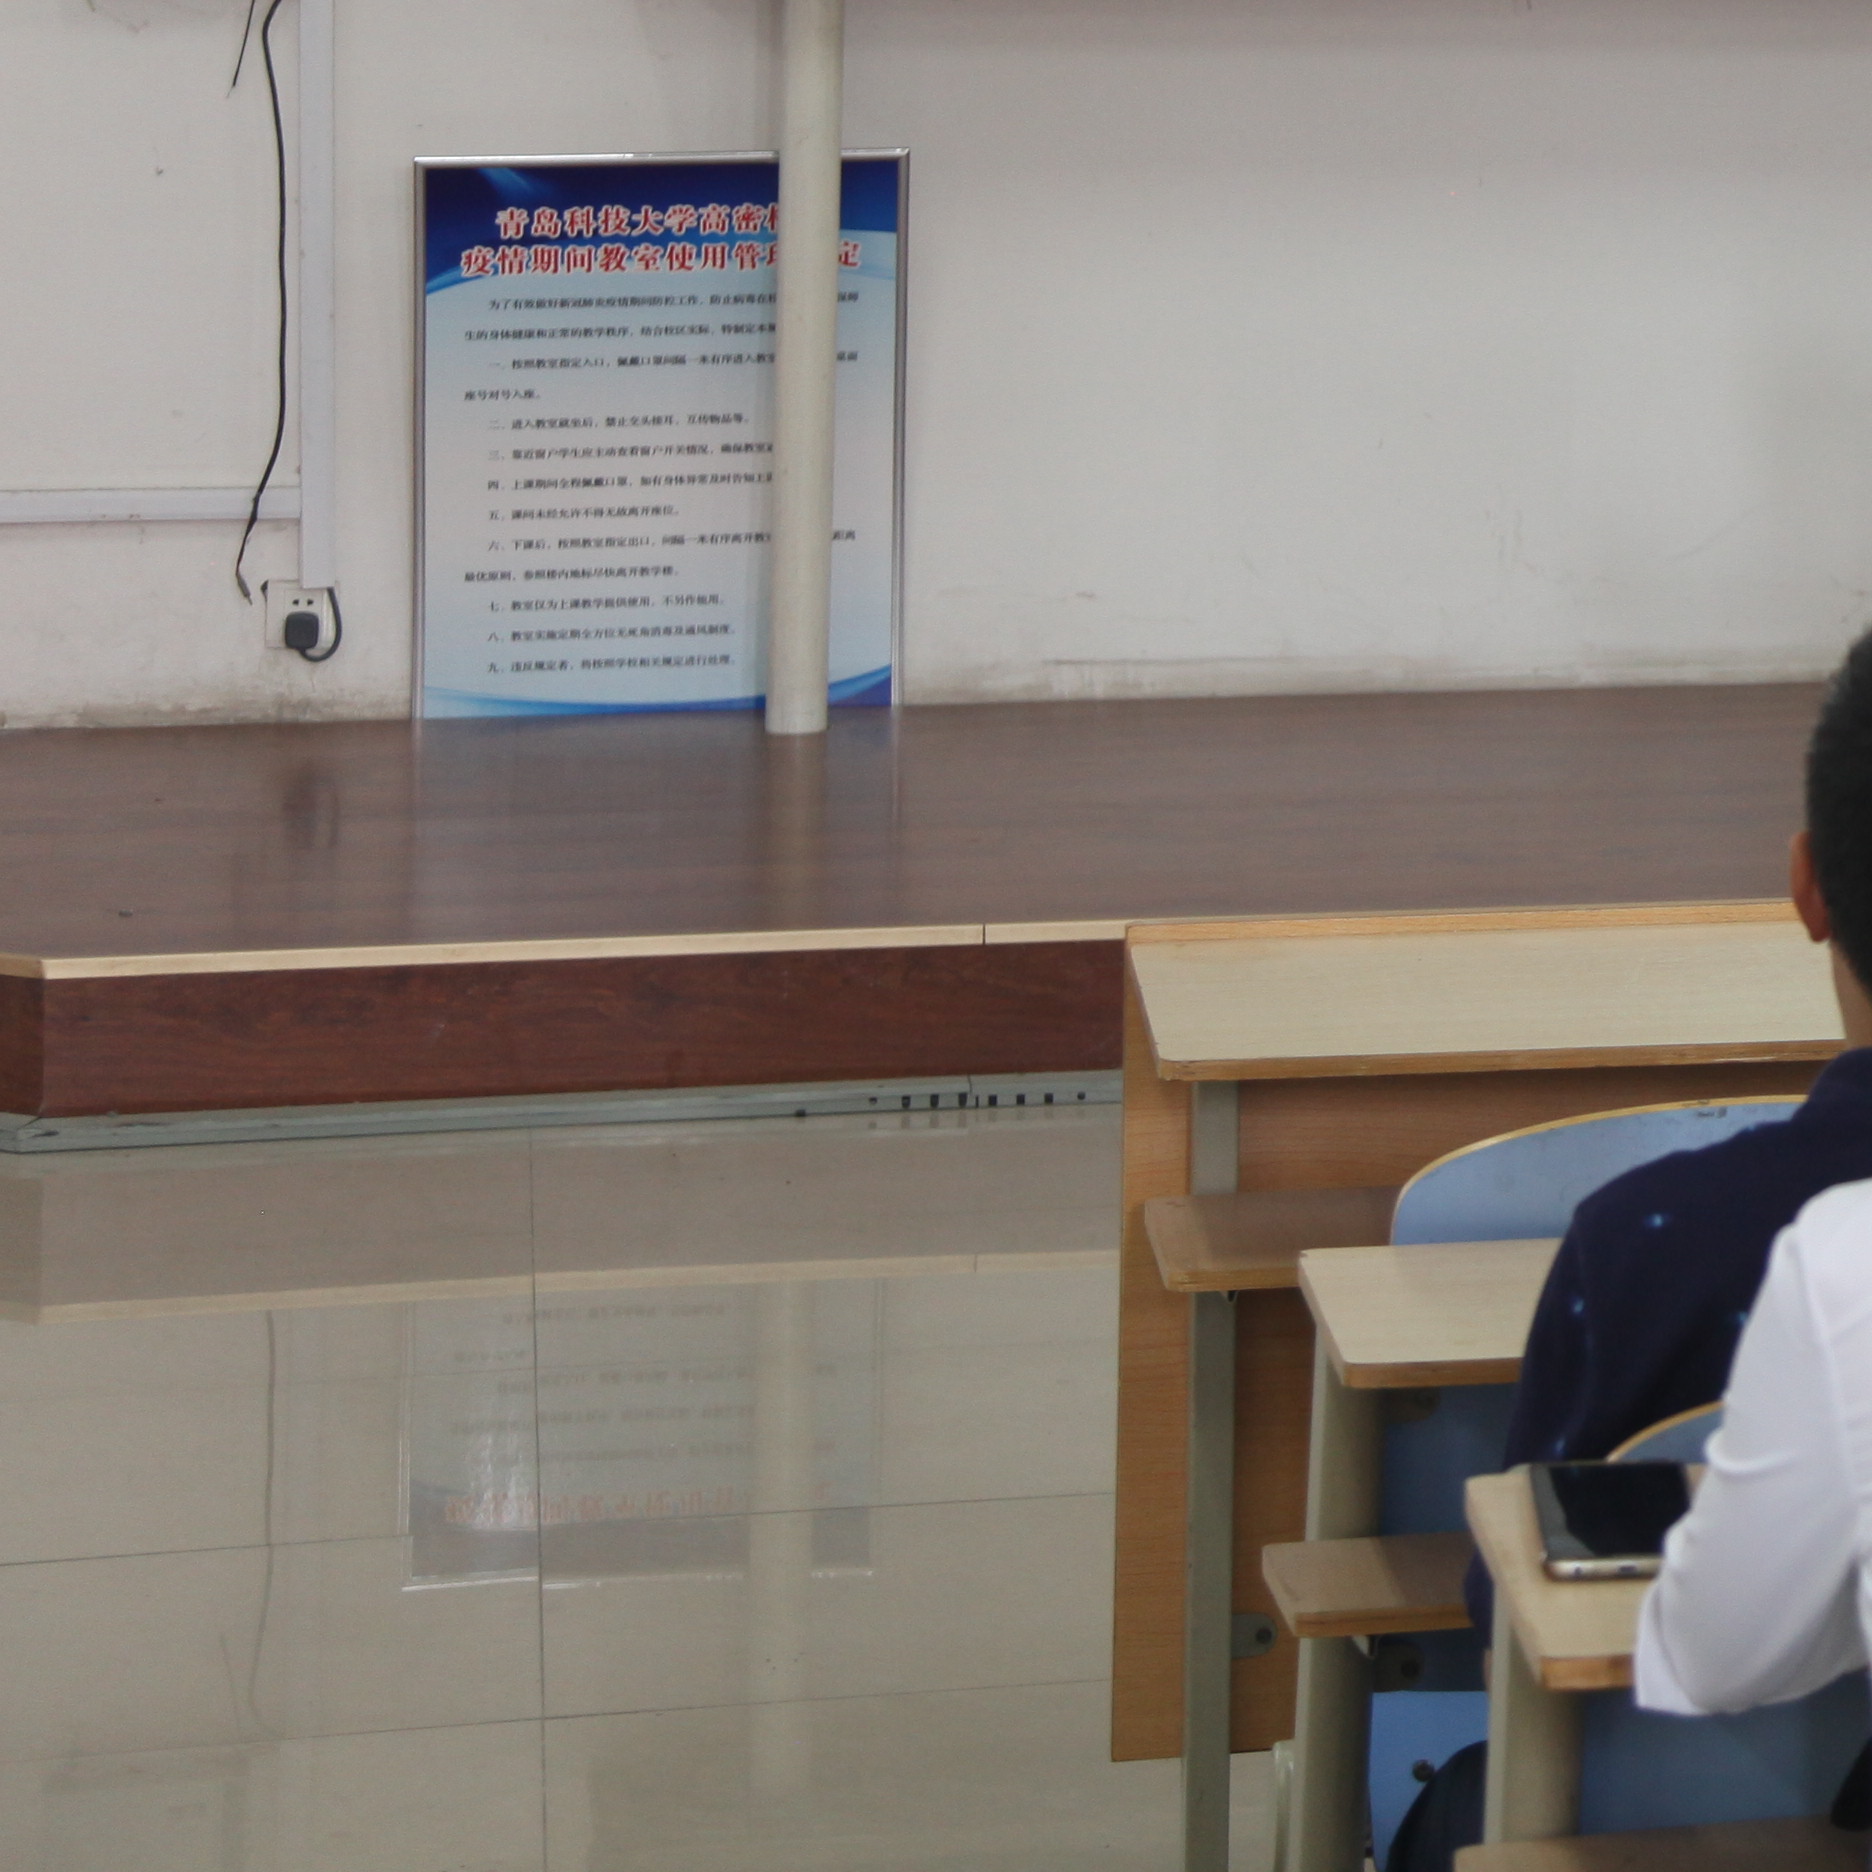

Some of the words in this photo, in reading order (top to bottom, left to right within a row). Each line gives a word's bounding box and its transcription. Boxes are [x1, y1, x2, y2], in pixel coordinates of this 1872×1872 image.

[461, 239, 862, 278] 疫情期间教室使用管定
